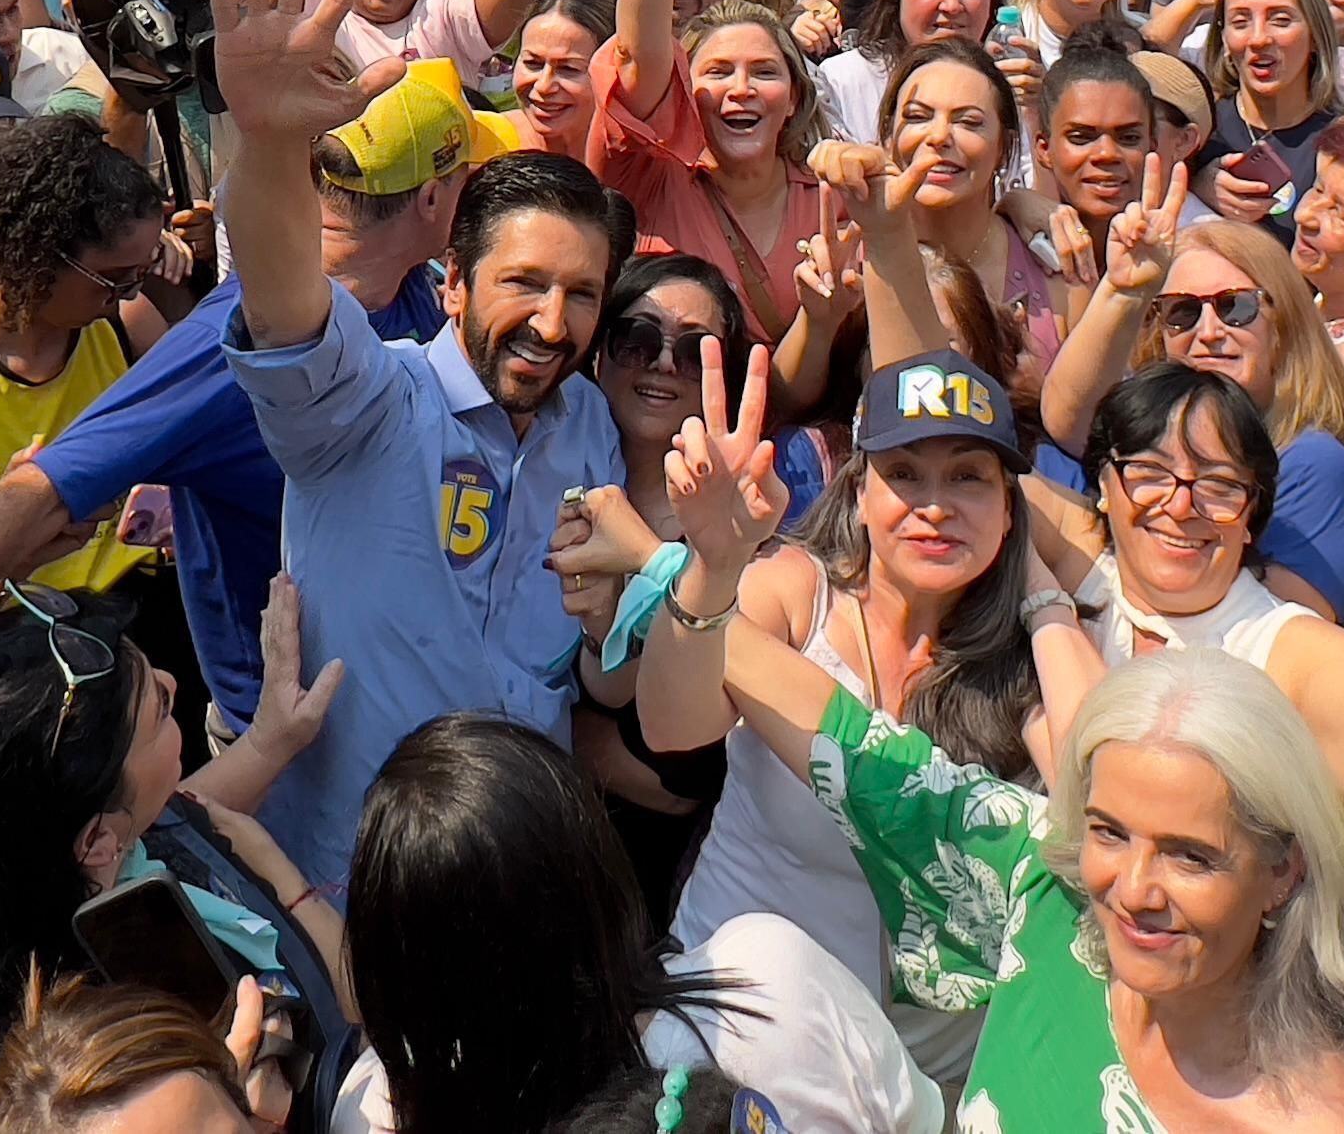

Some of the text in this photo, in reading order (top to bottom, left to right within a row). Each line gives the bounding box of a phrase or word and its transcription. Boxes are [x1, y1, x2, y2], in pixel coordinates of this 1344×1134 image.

[897, 363, 995, 426] R15
[456, 471, 477, 485] VOTE
[439, 480, 494, 556] 15
